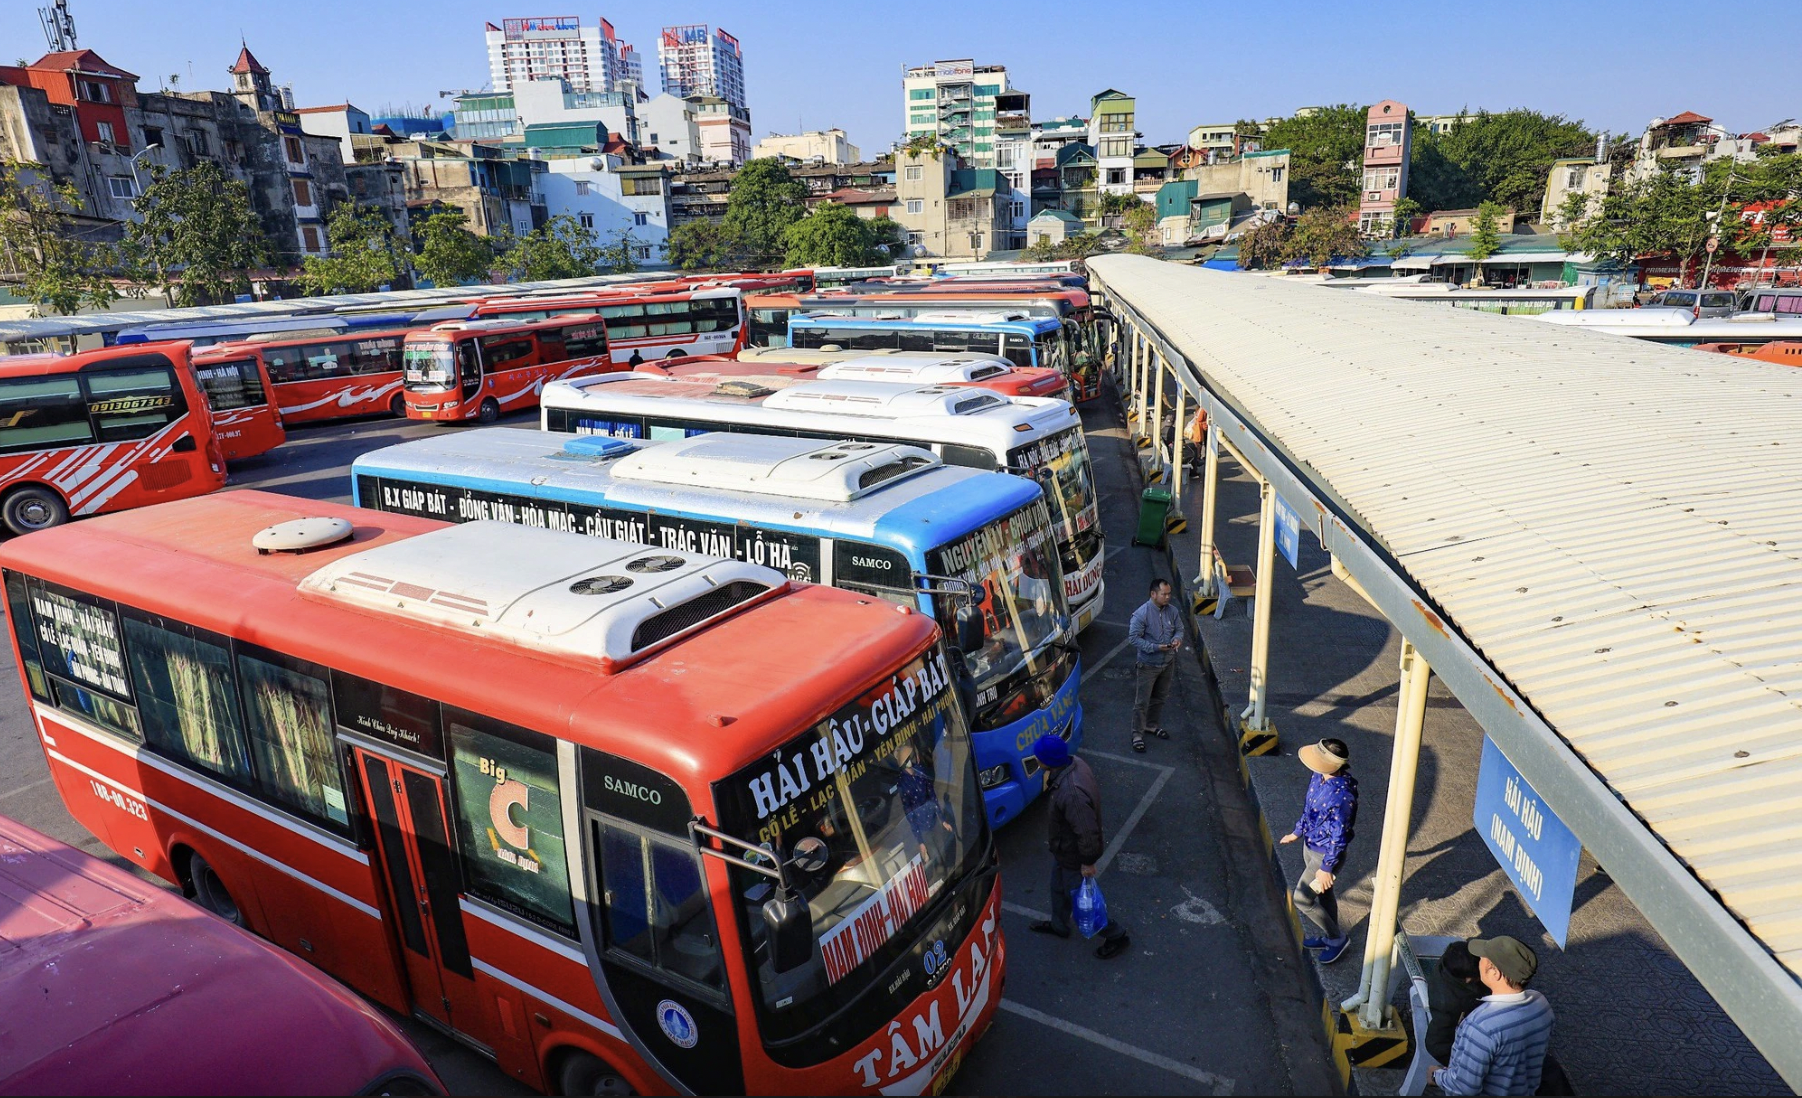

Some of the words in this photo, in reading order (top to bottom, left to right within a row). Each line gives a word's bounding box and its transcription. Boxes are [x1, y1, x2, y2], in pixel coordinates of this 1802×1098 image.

[91, 397, 172, 412] 0913067343
[384, 486, 400, 507] B.X
[402, 485, 425, 511] GIÁP
[427, 487, 447, 515] BÁT
[459, 491, 489, 520] ĐỒNG
[490, 498, 514, 523] VĂN
[521, 502, 544, 528] HÒA
[585, 508, 612, 538] CẦU
[615, 517, 645, 545] GIÁT
[659, 524, 697, 553] TRÁC
[700, 526, 731, 558] VĂN
[746, 530, 764, 566] LỖ
[770, 538, 792, 569] HÀ
[852, 554, 892, 571] SAMCO
[940, 531, 993, 576] NGUYÊN
[34, 596, 54, 619] NAM
[1064, 574, 1082, 598] HẢI
[748, 748, 811, 820] HẢI
[810, 713, 865, 782] HẬU
[871, 675, 917, 736] GIÁP
[917, 650, 950, 704] BÁT
[479, 756, 506, 785] Big
[810, 784, 835, 812] LẠC
[873, 740, 895, 763] YÊN
[921, 707, 936, 727] HẢI
[89, 779, 148, 821] 18B-00.323
[604, 774, 661, 805] SAMCO
[1504, 776, 1522, 817] HẢI
[1521, 798, 1543, 841] HẬU
[489, 778, 529, 850] C
[1490, 812, 1516, 862] (NAM
[1514, 842, 1543, 902] ĐỊNH)
[821, 924, 858, 987] NAM
[923, 939, 947, 975] 02
[853, 999, 946, 1088] TÂM
